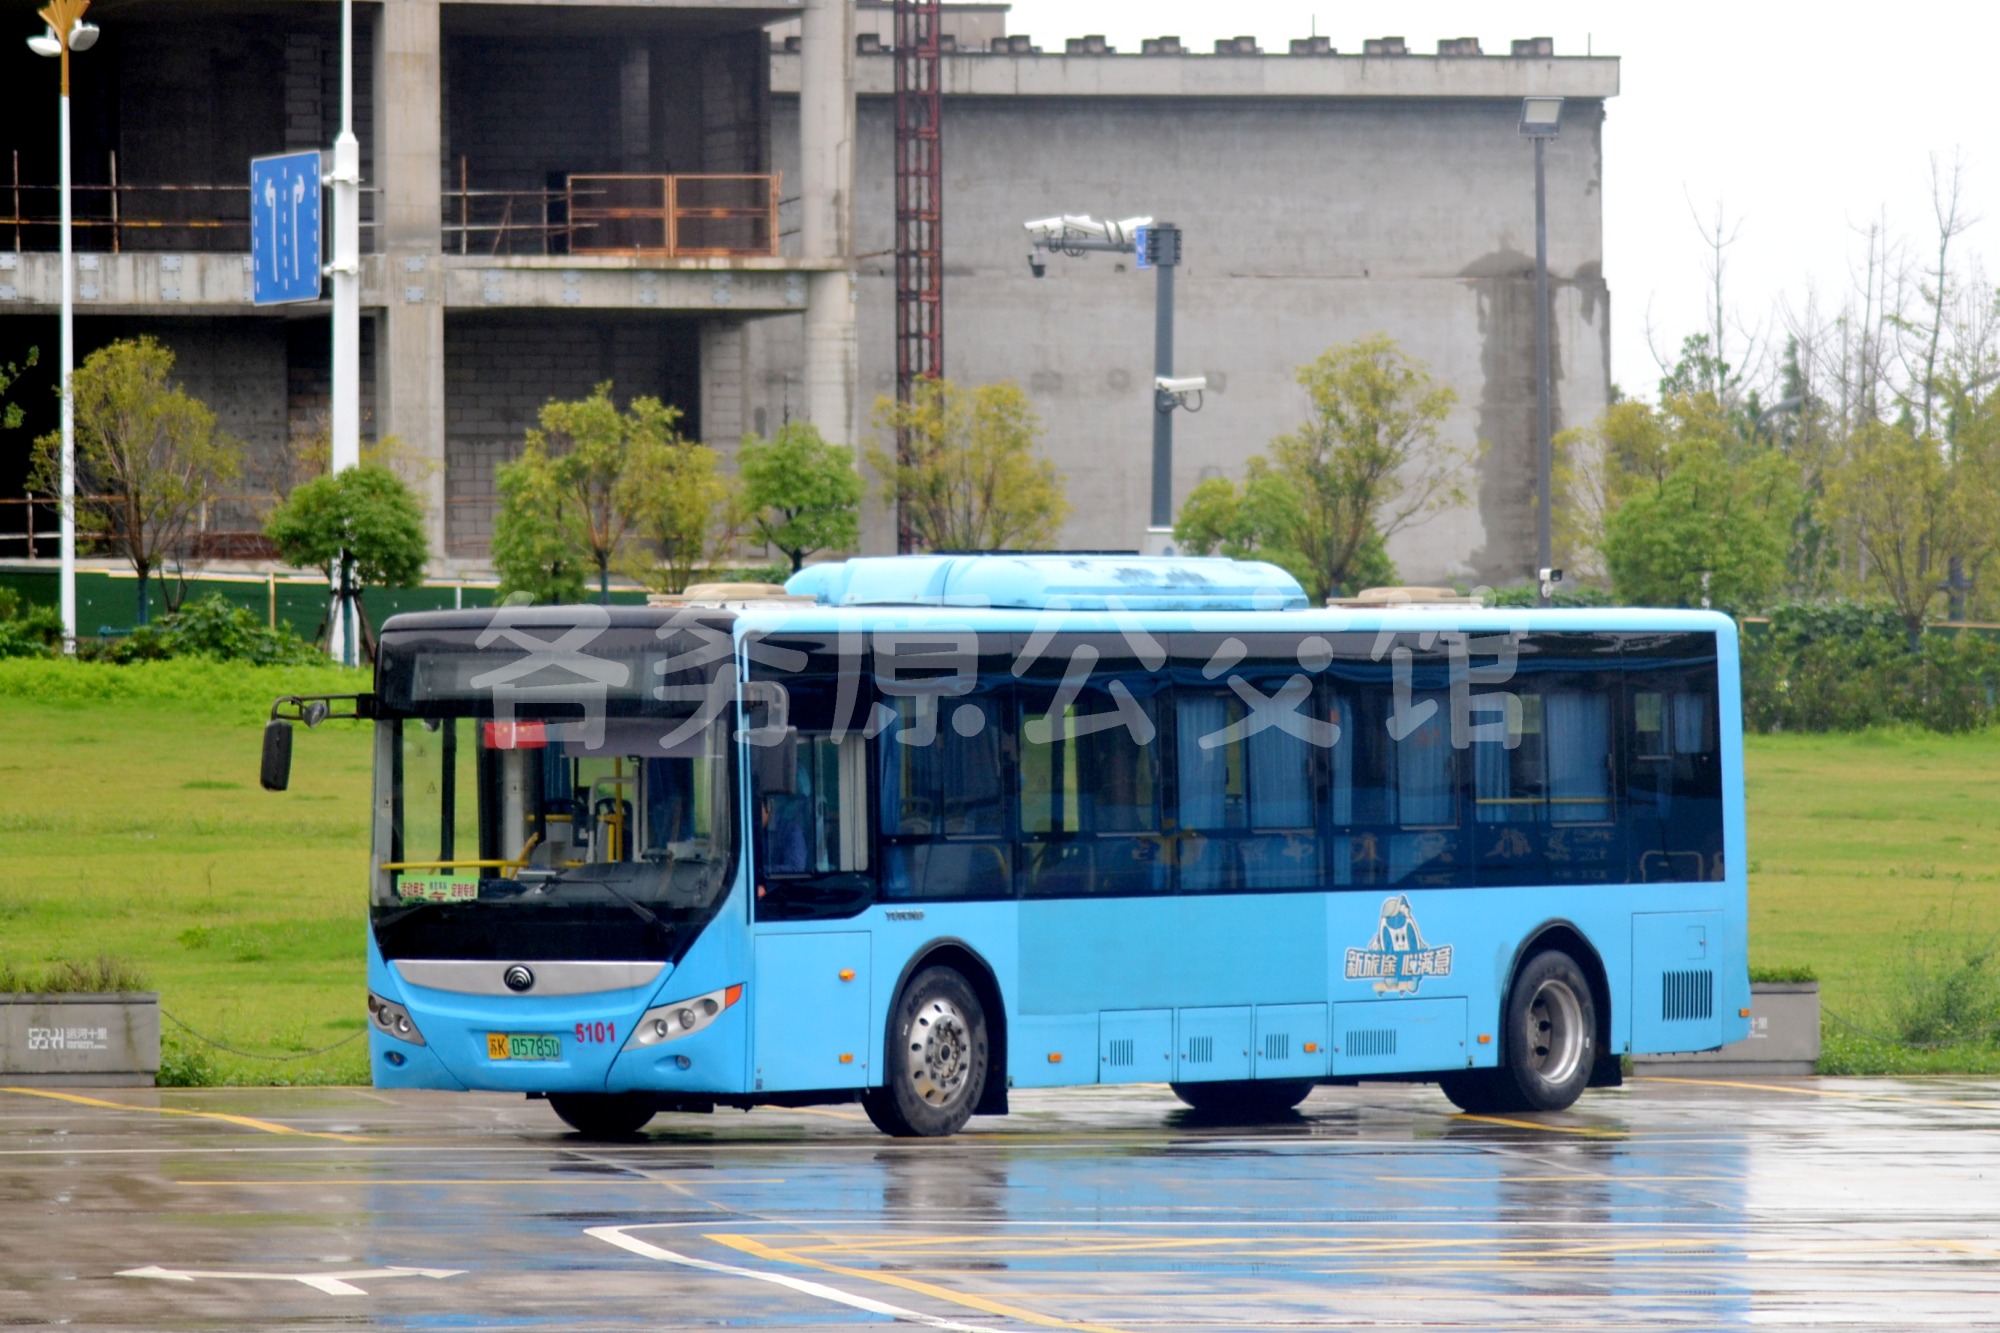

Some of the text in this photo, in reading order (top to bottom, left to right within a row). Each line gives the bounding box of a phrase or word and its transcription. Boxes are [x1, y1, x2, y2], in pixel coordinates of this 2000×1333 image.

[1346, 950, 1398, 977] 新旅途
[574, 1021, 616, 1043] 5101
